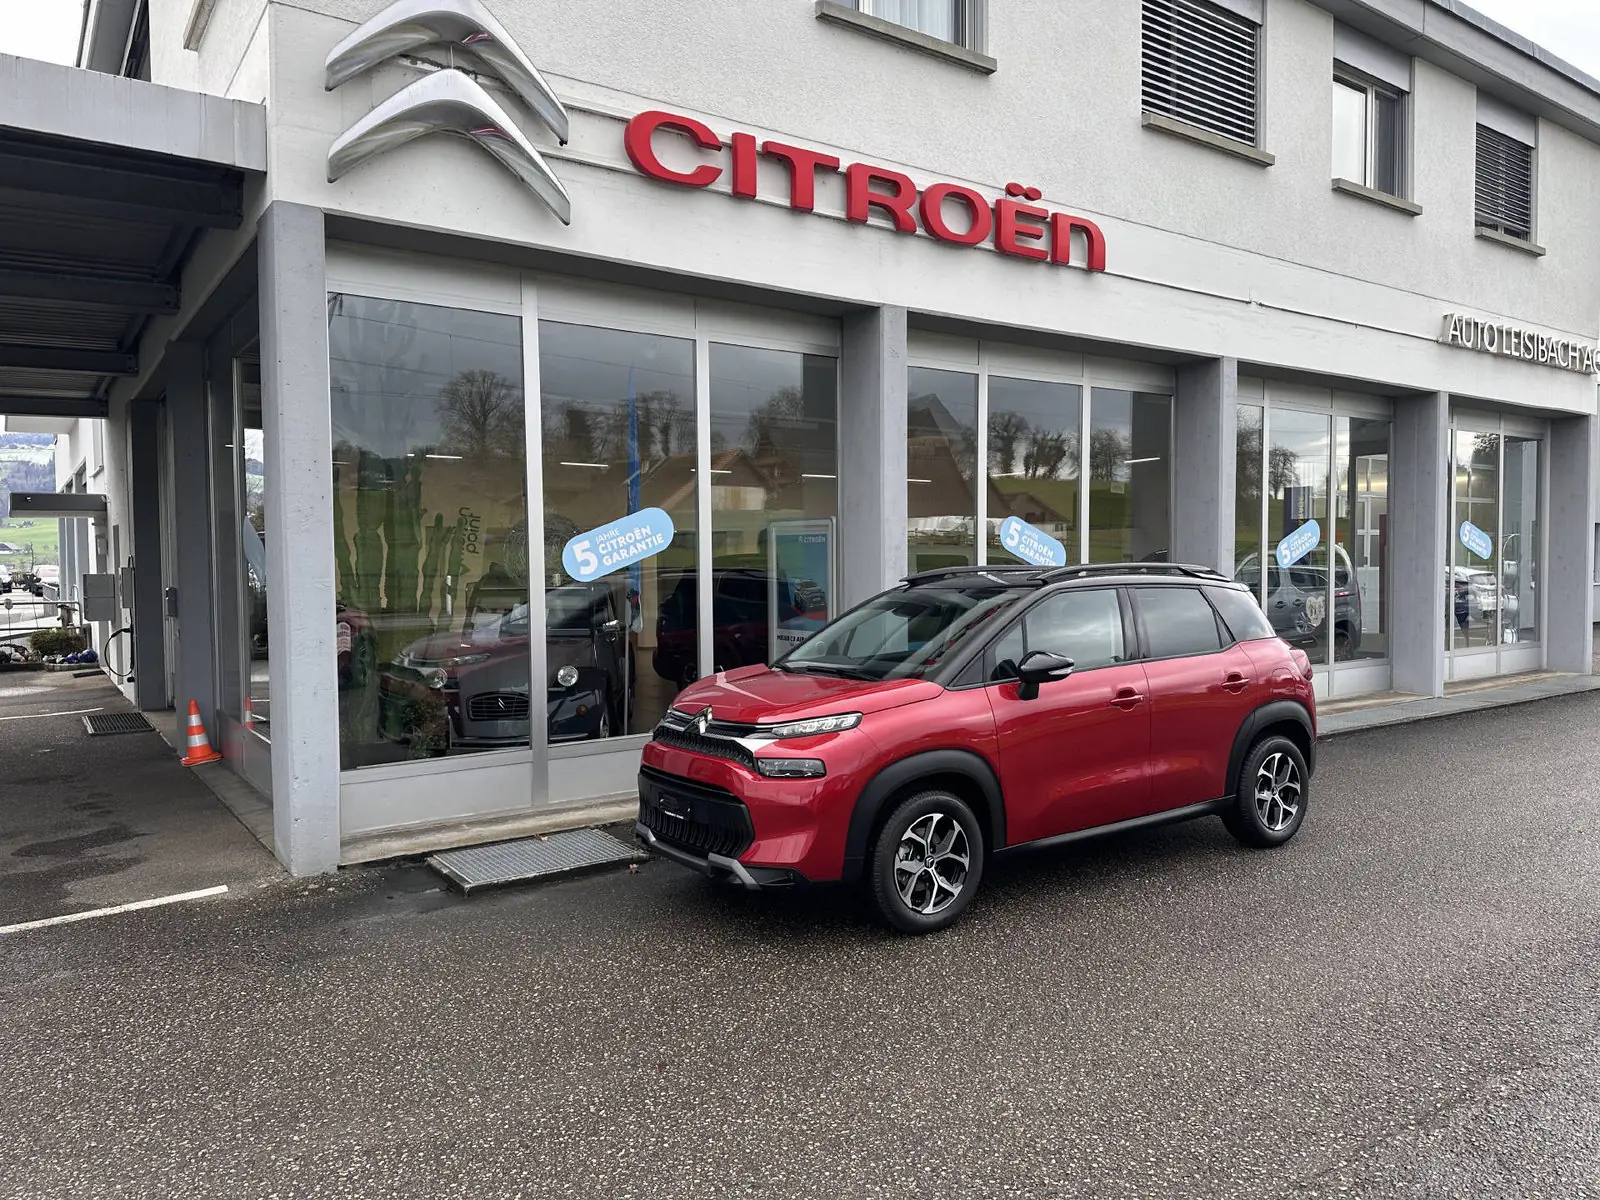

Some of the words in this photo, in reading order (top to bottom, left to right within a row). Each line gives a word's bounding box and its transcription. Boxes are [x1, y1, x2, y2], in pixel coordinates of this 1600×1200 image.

[1443, 311, 1498, 353] AUTO
[1502, 324, 1579, 370] LEISIBACH
[466, 514, 481, 554] point
[595, 528, 620, 544] JAHRE
[598, 525, 652, 554] CITROËN
[1005, 521, 1021, 547] 5
[572, 540, 598, 575] 5
[602, 534, 664, 566] GARANTIE
[1280, 543, 1291, 564] 5
